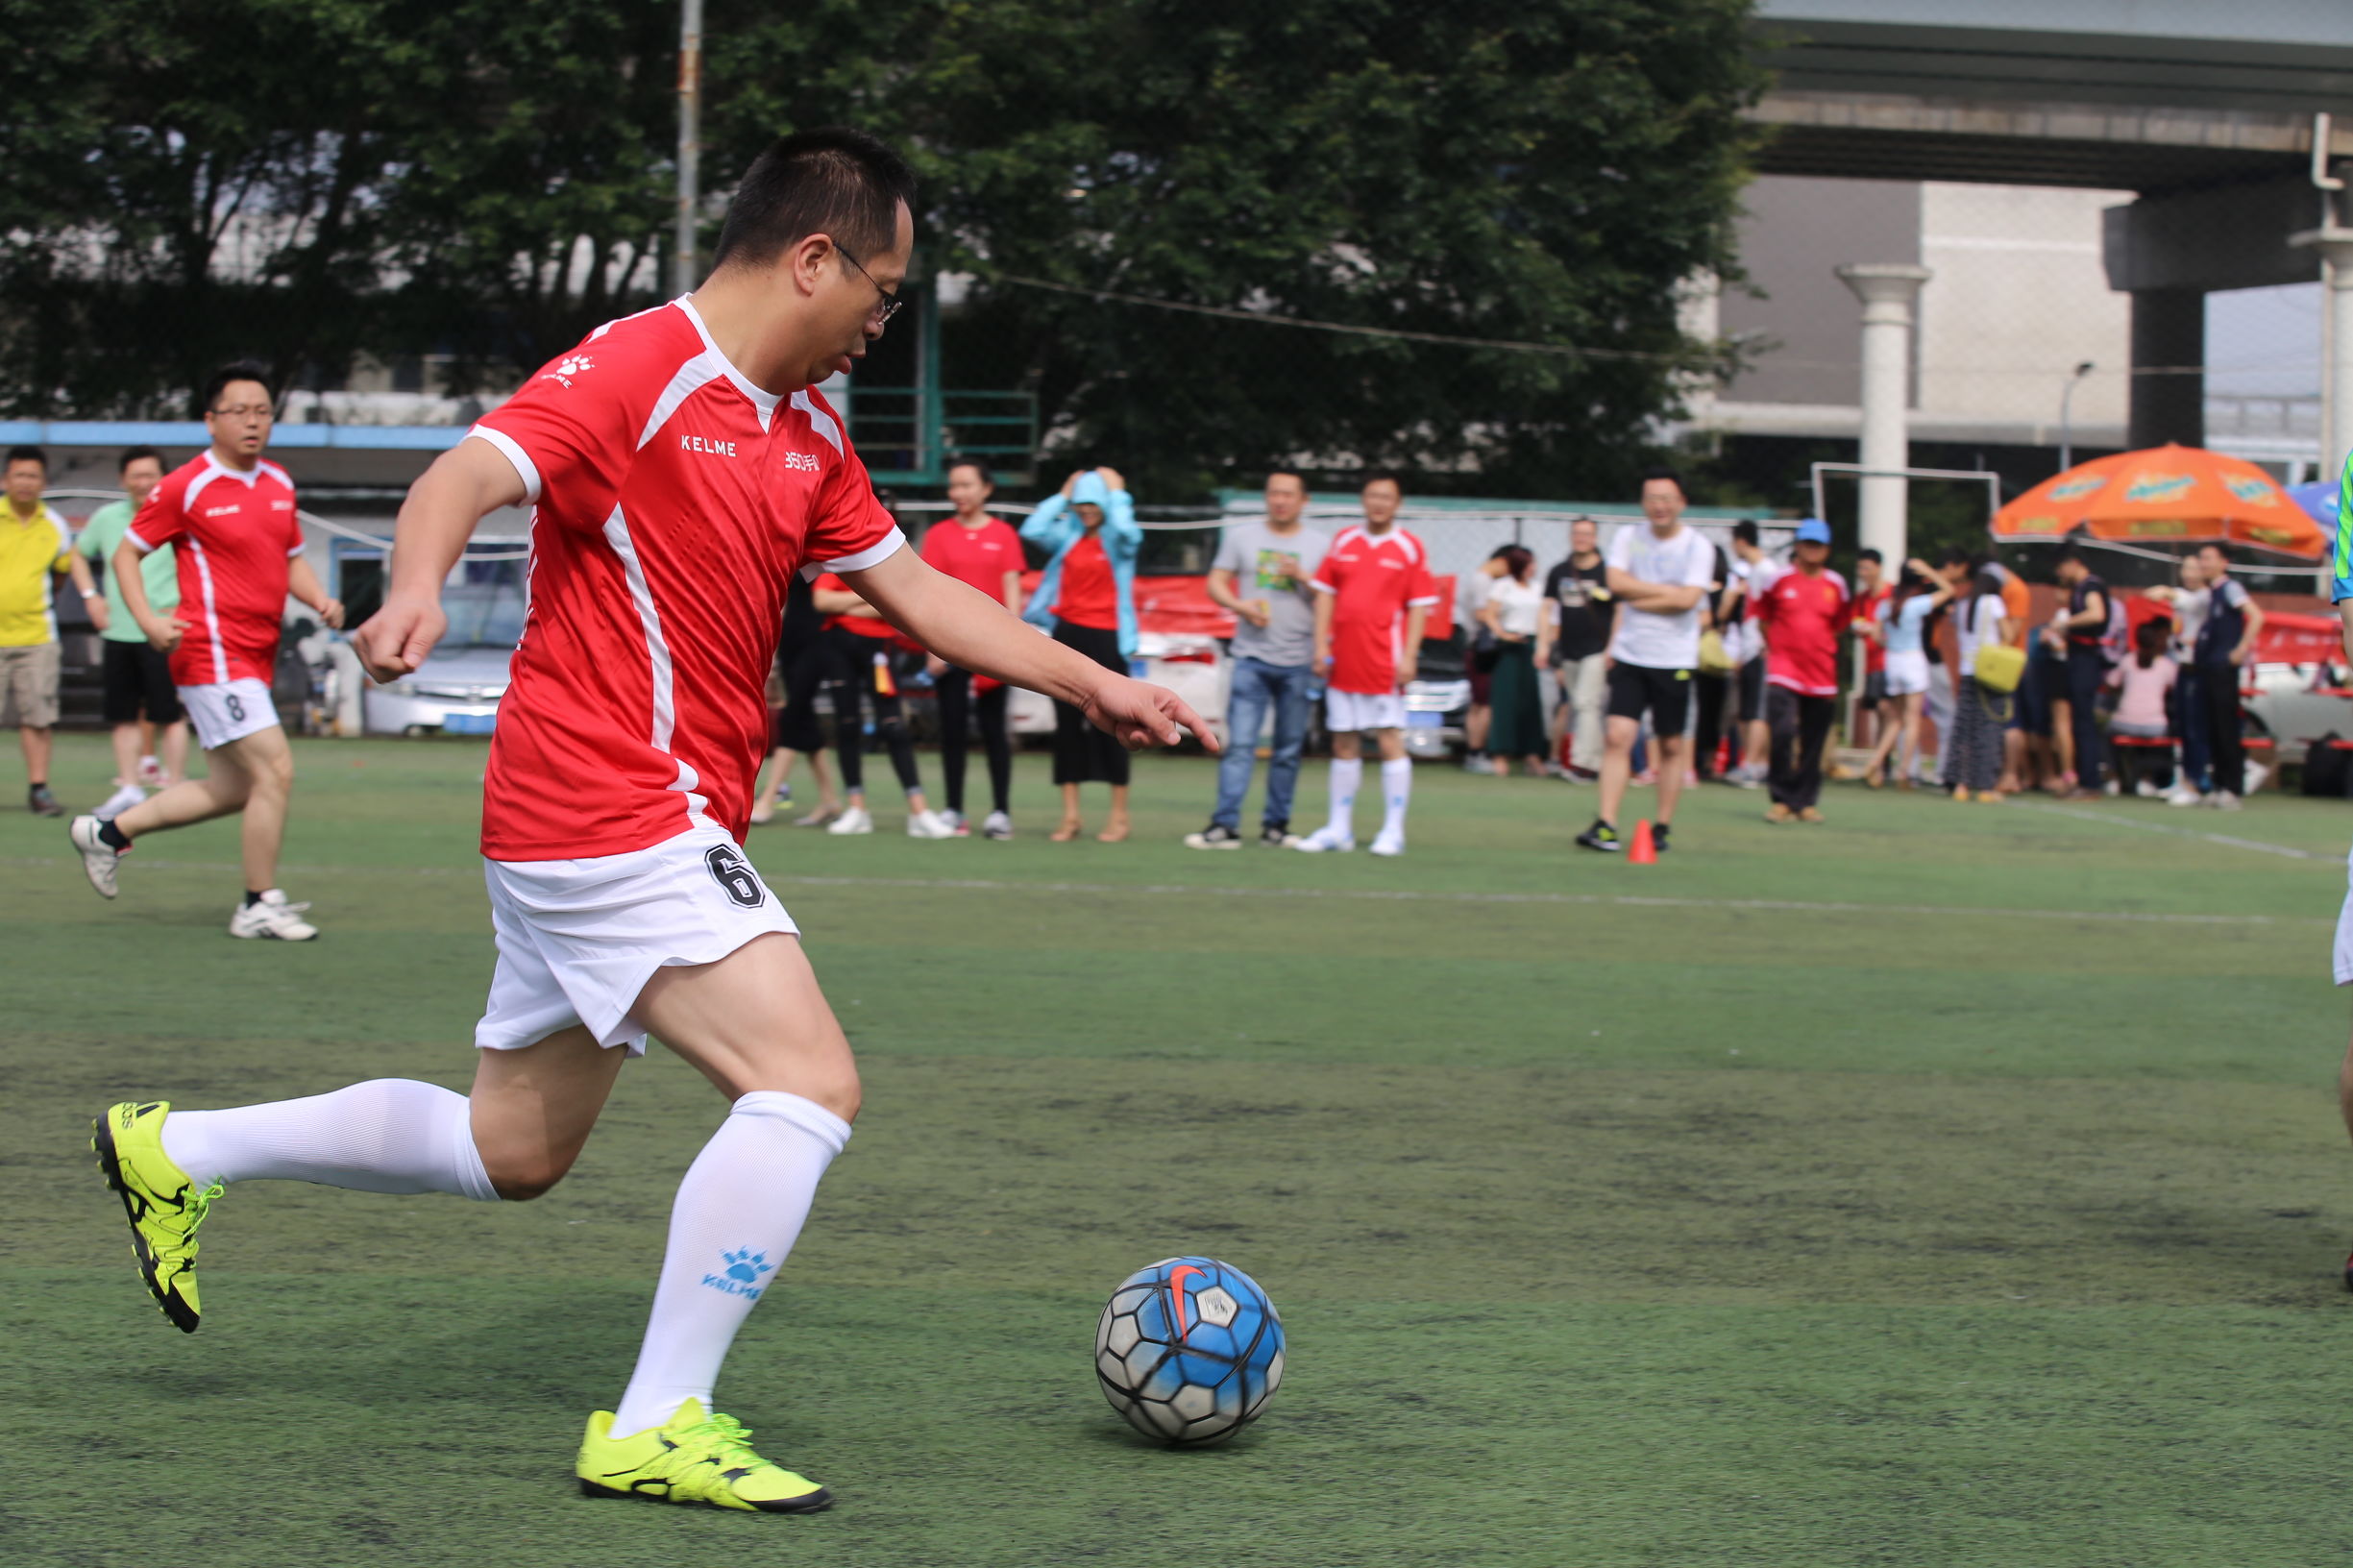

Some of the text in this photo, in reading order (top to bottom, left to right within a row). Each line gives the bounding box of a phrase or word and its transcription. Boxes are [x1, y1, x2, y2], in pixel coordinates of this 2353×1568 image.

[681, 435, 737, 457] KELME
[226, 694, 245, 722] 8
[704, 843, 766, 909] 6
[701, 1274, 762, 1300] KELME
